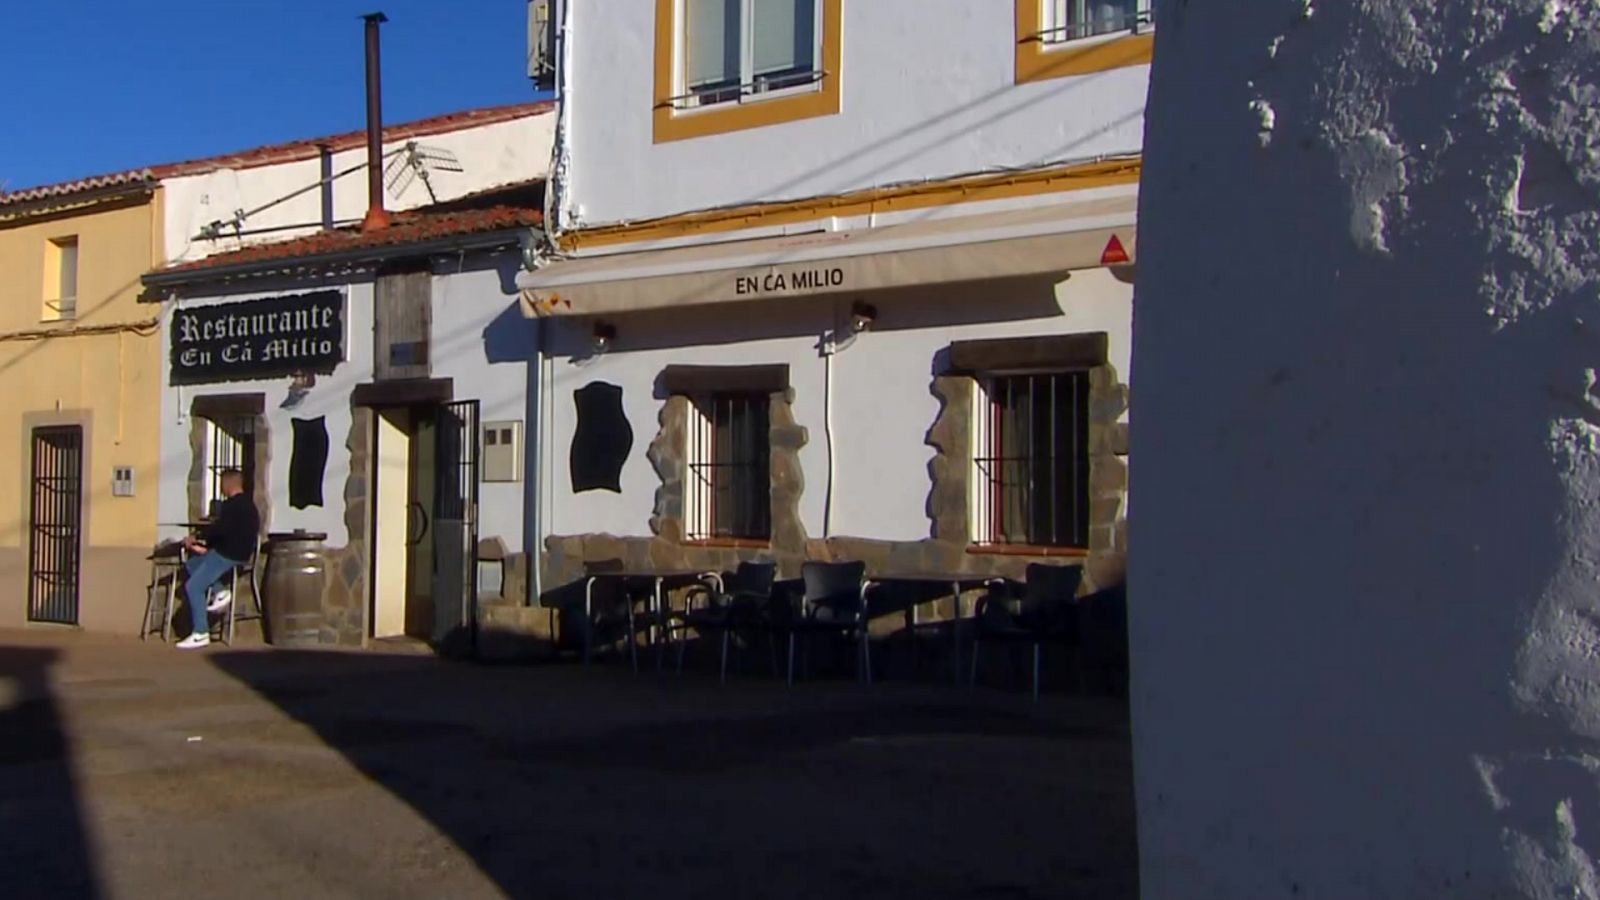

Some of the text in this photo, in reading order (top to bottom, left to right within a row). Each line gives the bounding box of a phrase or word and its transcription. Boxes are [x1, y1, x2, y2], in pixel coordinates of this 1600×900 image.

[736, 268, 844, 294] EN CA MILIO
[180, 304, 333, 342] Restaurante
[180, 348, 211, 366] En
[261, 337, 332, 361] Milio
